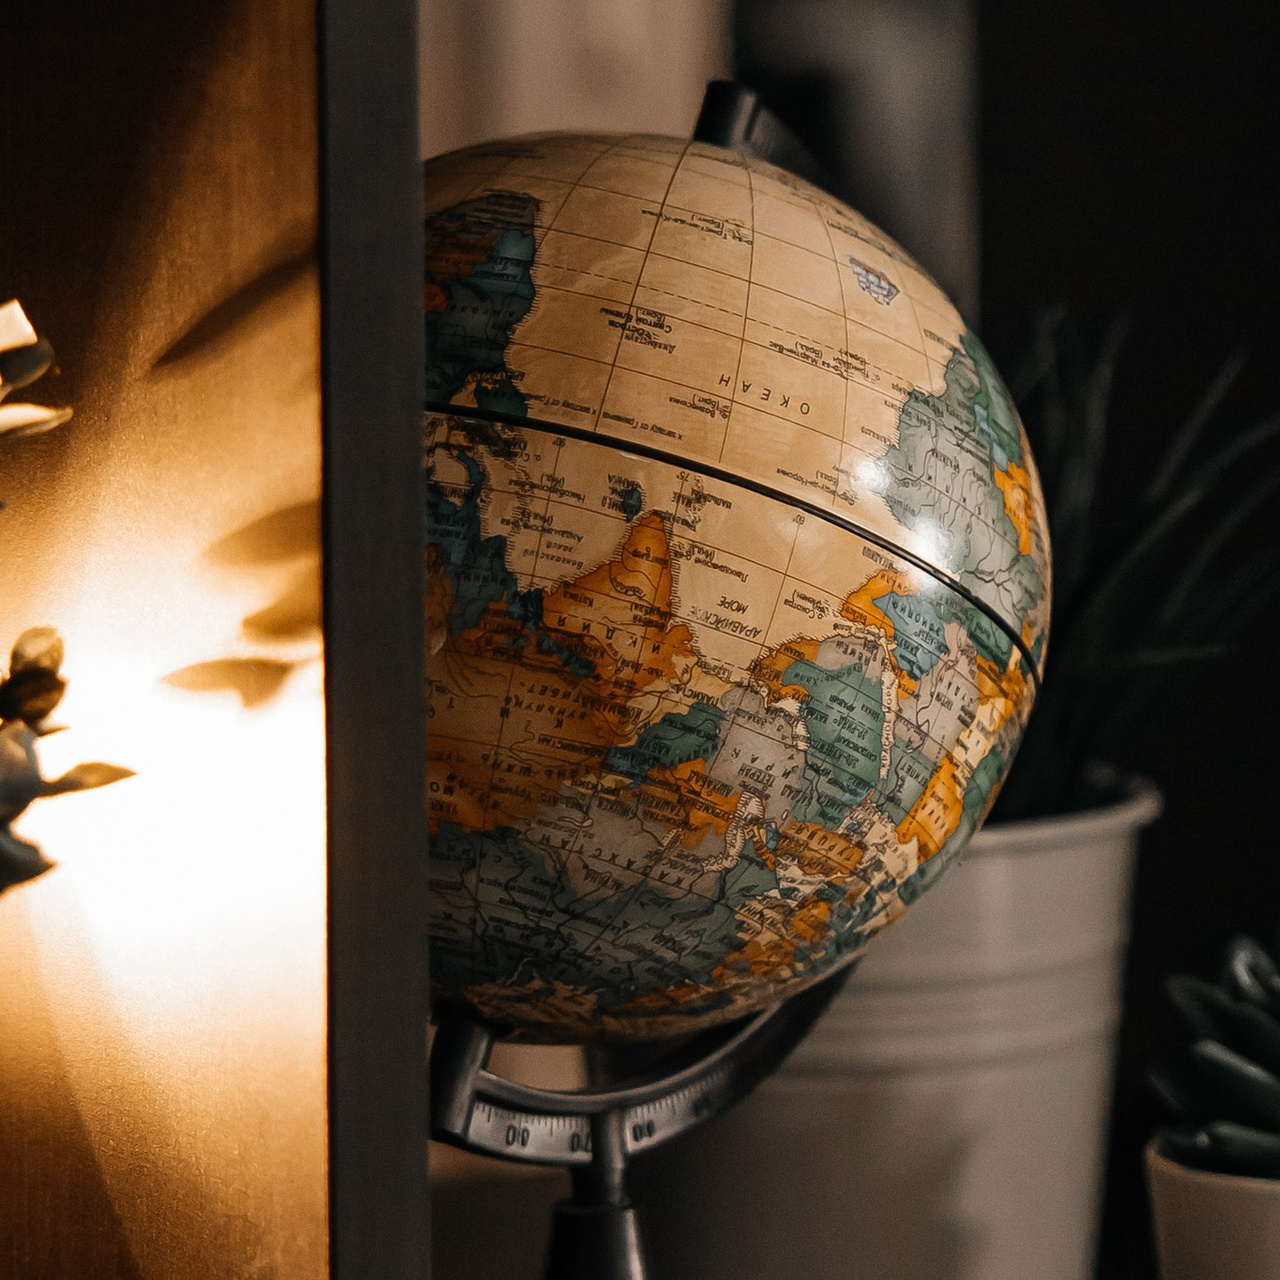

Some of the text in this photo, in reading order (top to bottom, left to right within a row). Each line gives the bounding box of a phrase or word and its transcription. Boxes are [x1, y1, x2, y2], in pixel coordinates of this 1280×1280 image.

[718, 373, 811, 416] ОКЕАН
[716, 595, 749, 615] МОРЕ
[783, 598, 816, 619] Сокотра
[736, 763, 776, 788] ТЕГЕРАН
